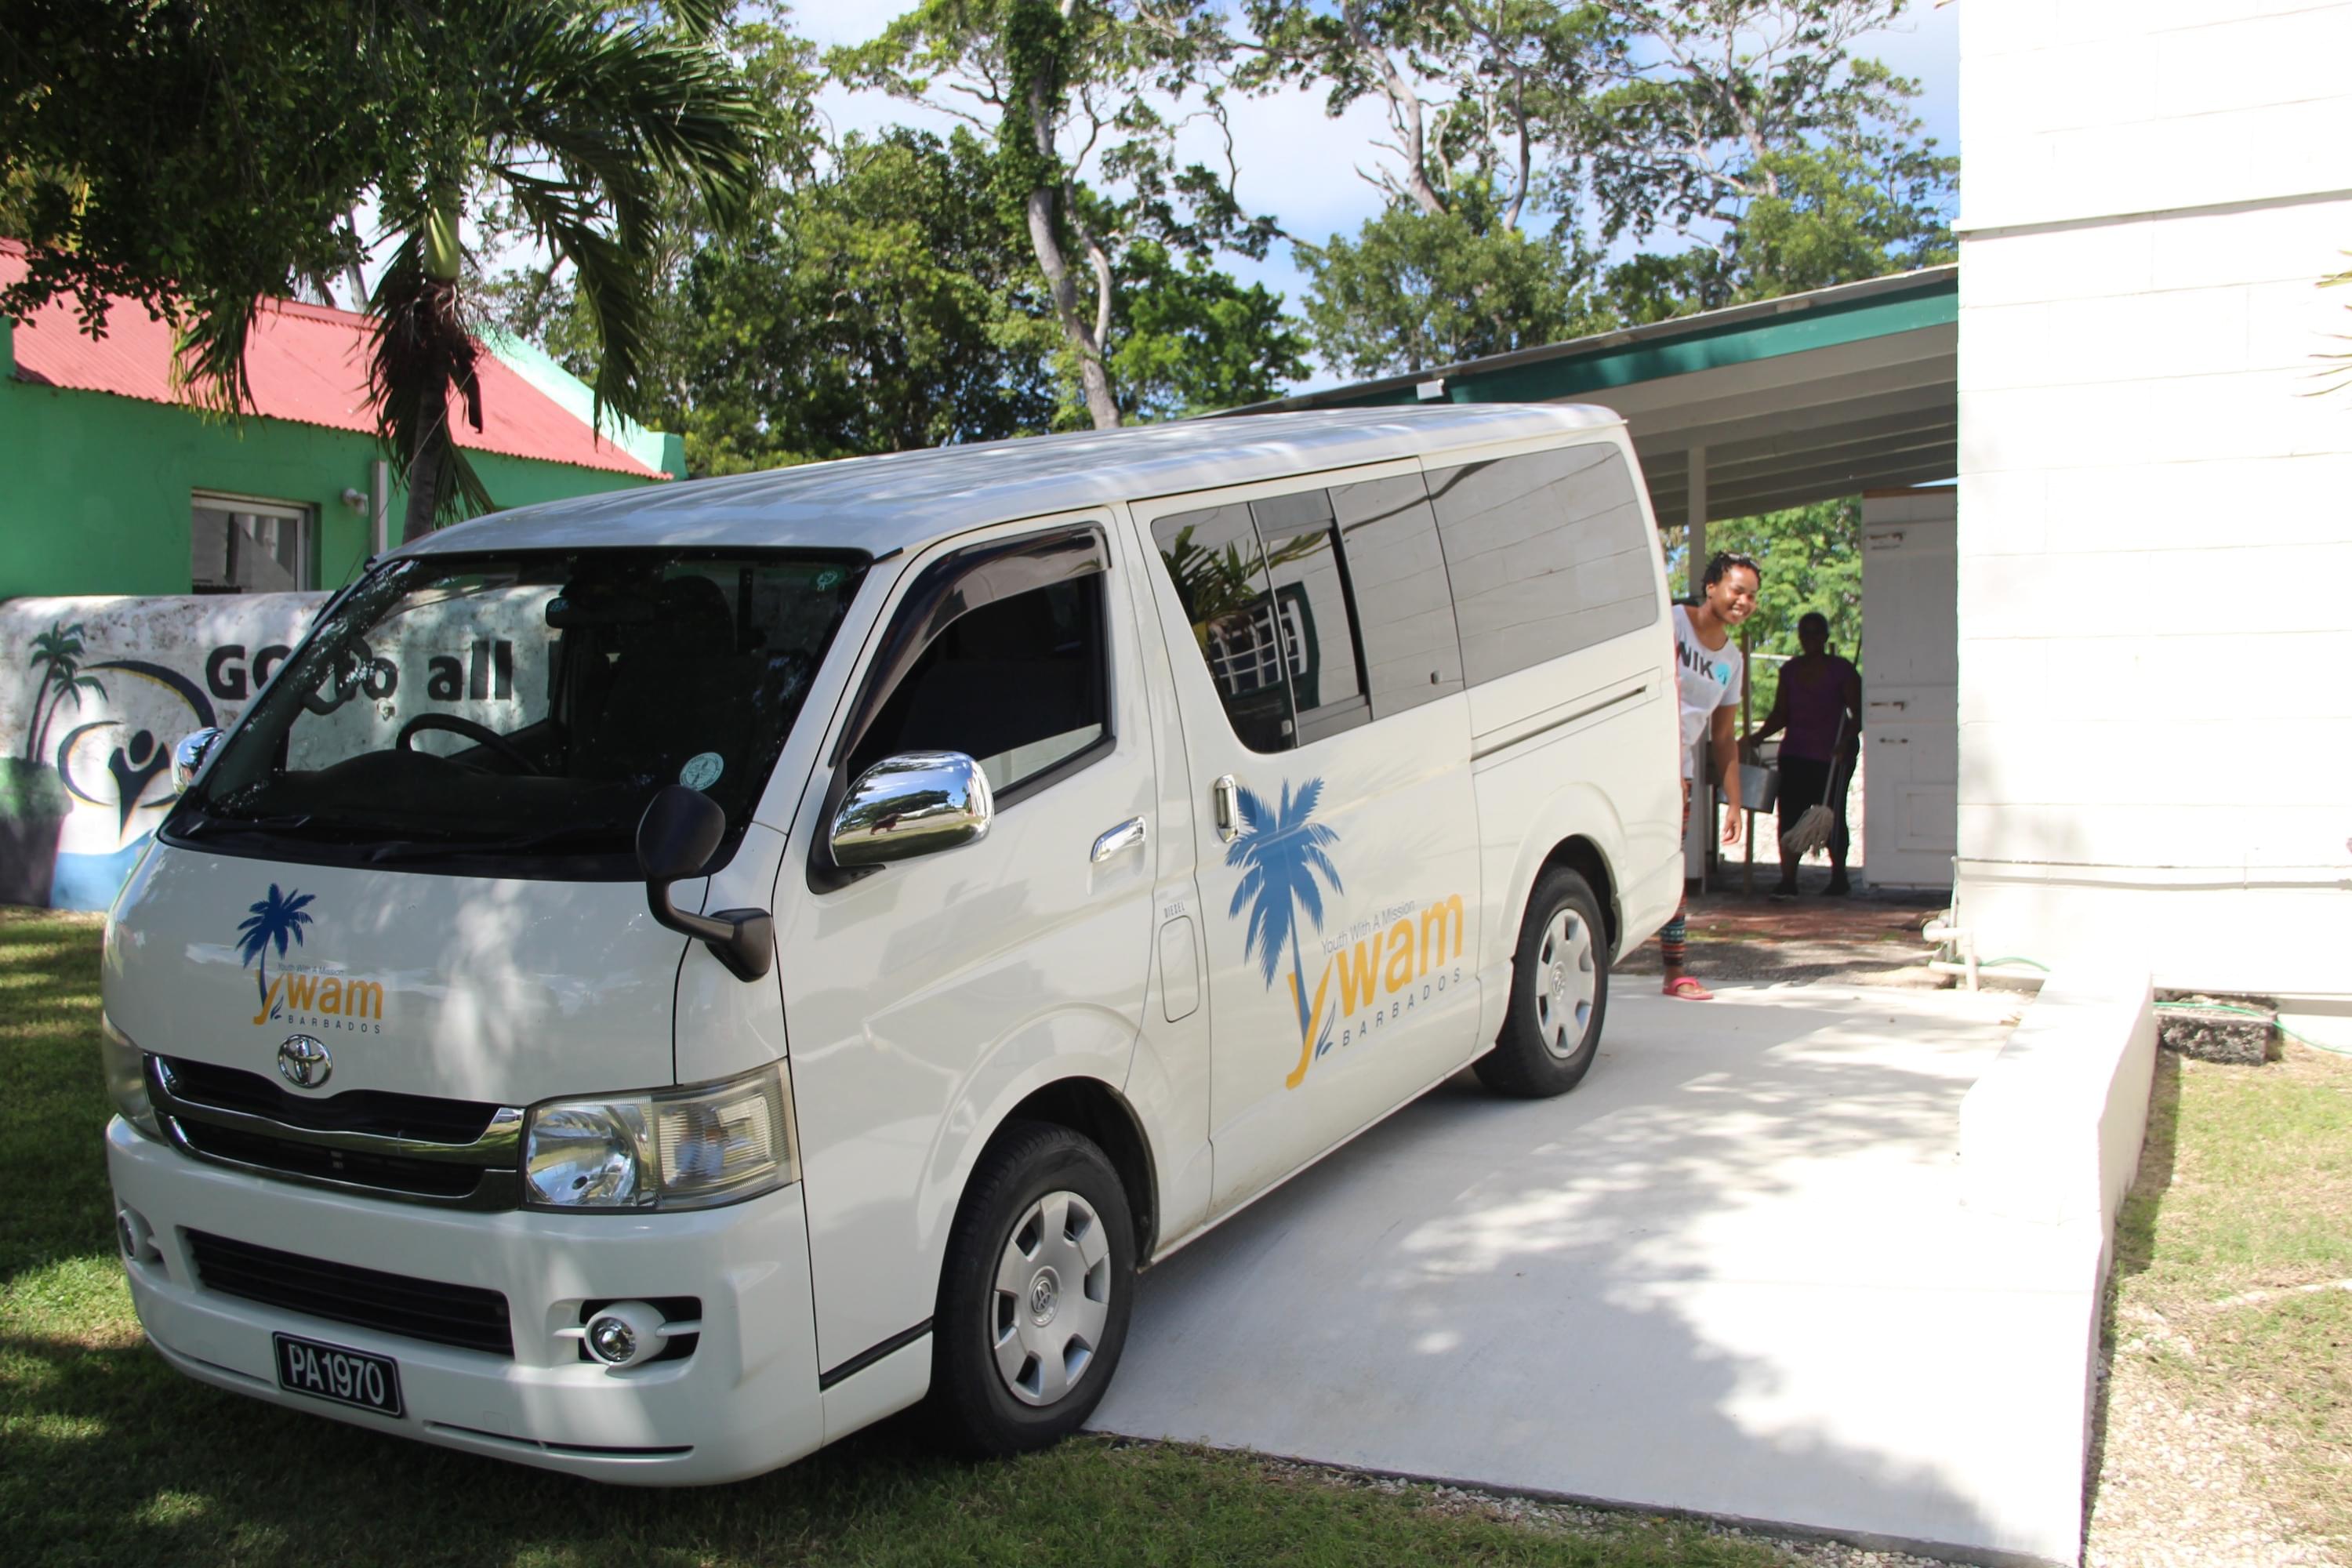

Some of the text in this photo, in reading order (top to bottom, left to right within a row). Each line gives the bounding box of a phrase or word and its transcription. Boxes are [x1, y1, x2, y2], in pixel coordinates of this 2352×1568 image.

[427, 640, 513, 701] all
[1164, 902, 1185, 917] DIESEL
[1321, 900, 1415, 955] Youth With A Mission
[252, 969, 384, 1025] ywam
[1285, 894, 1464, 1091] ywam
[1342, 967, 1461, 1047] BARBADOS
[288, 1014, 380, 1034] BARBADOS
[288, 1343, 385, 1405] PA1970
